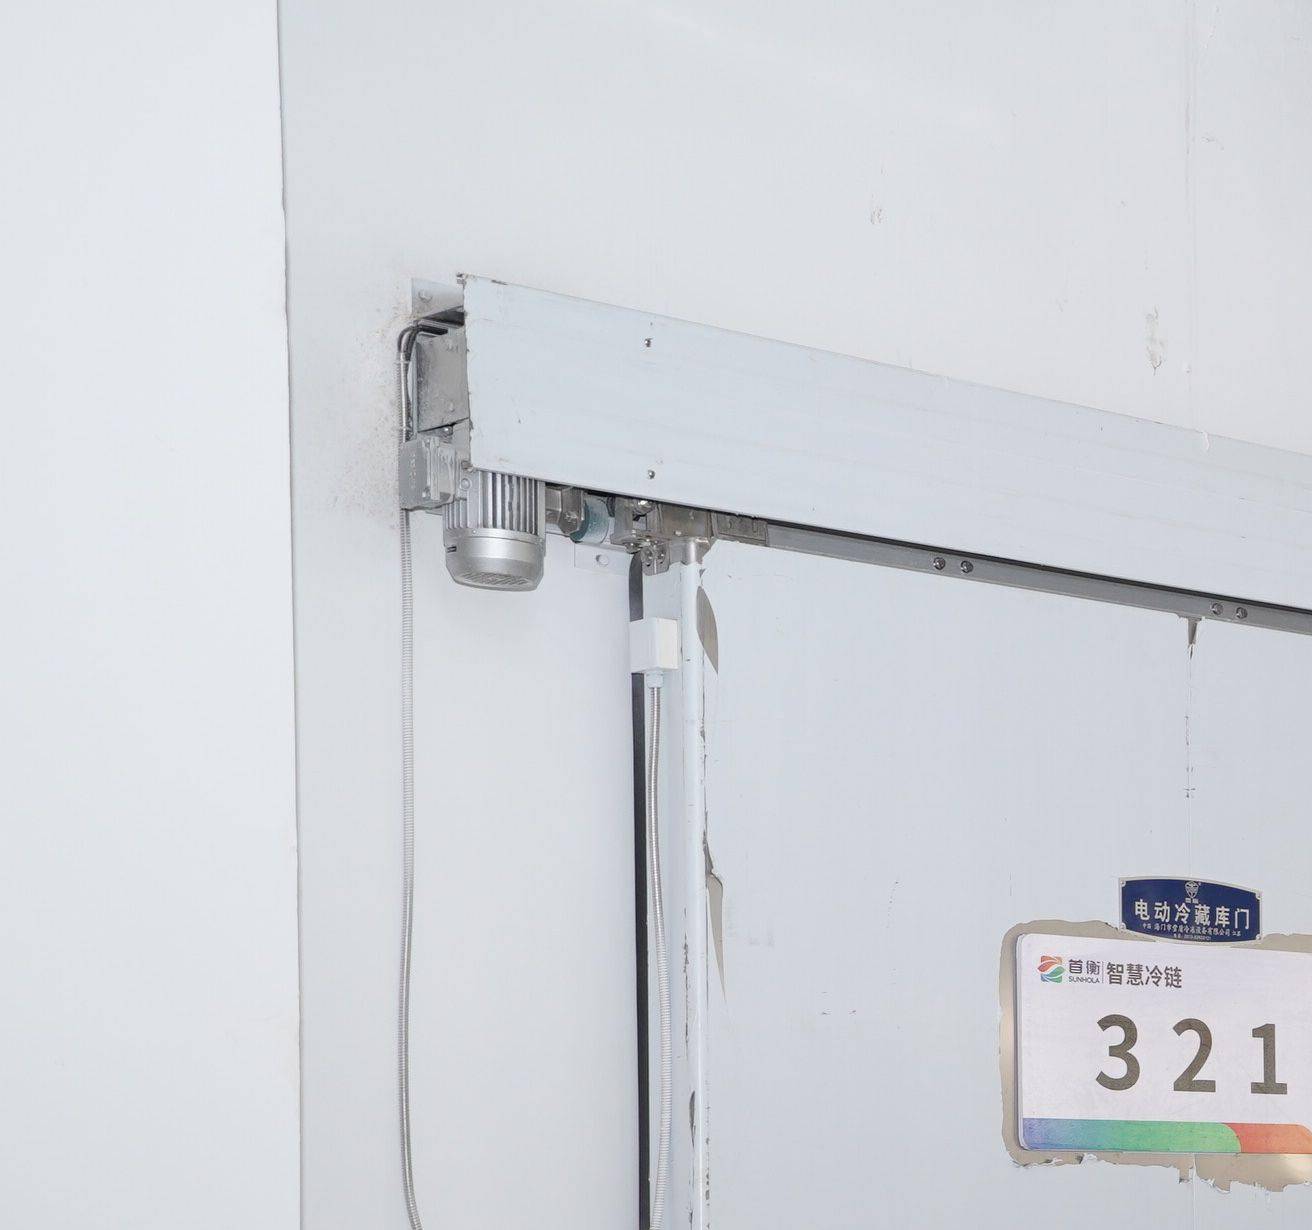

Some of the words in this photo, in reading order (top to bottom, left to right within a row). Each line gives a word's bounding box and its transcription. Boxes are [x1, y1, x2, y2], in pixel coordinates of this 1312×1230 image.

[1134, 898, 1251, 930] 电动冷藏库门
[1068, 958, 1100, 976] 首衡
[1106, 961, 1183, 989] 智慧冷链
[1068, 976, 1100, 984] SUNHOLA
[1095, 1013, 1289, 1096] 321
